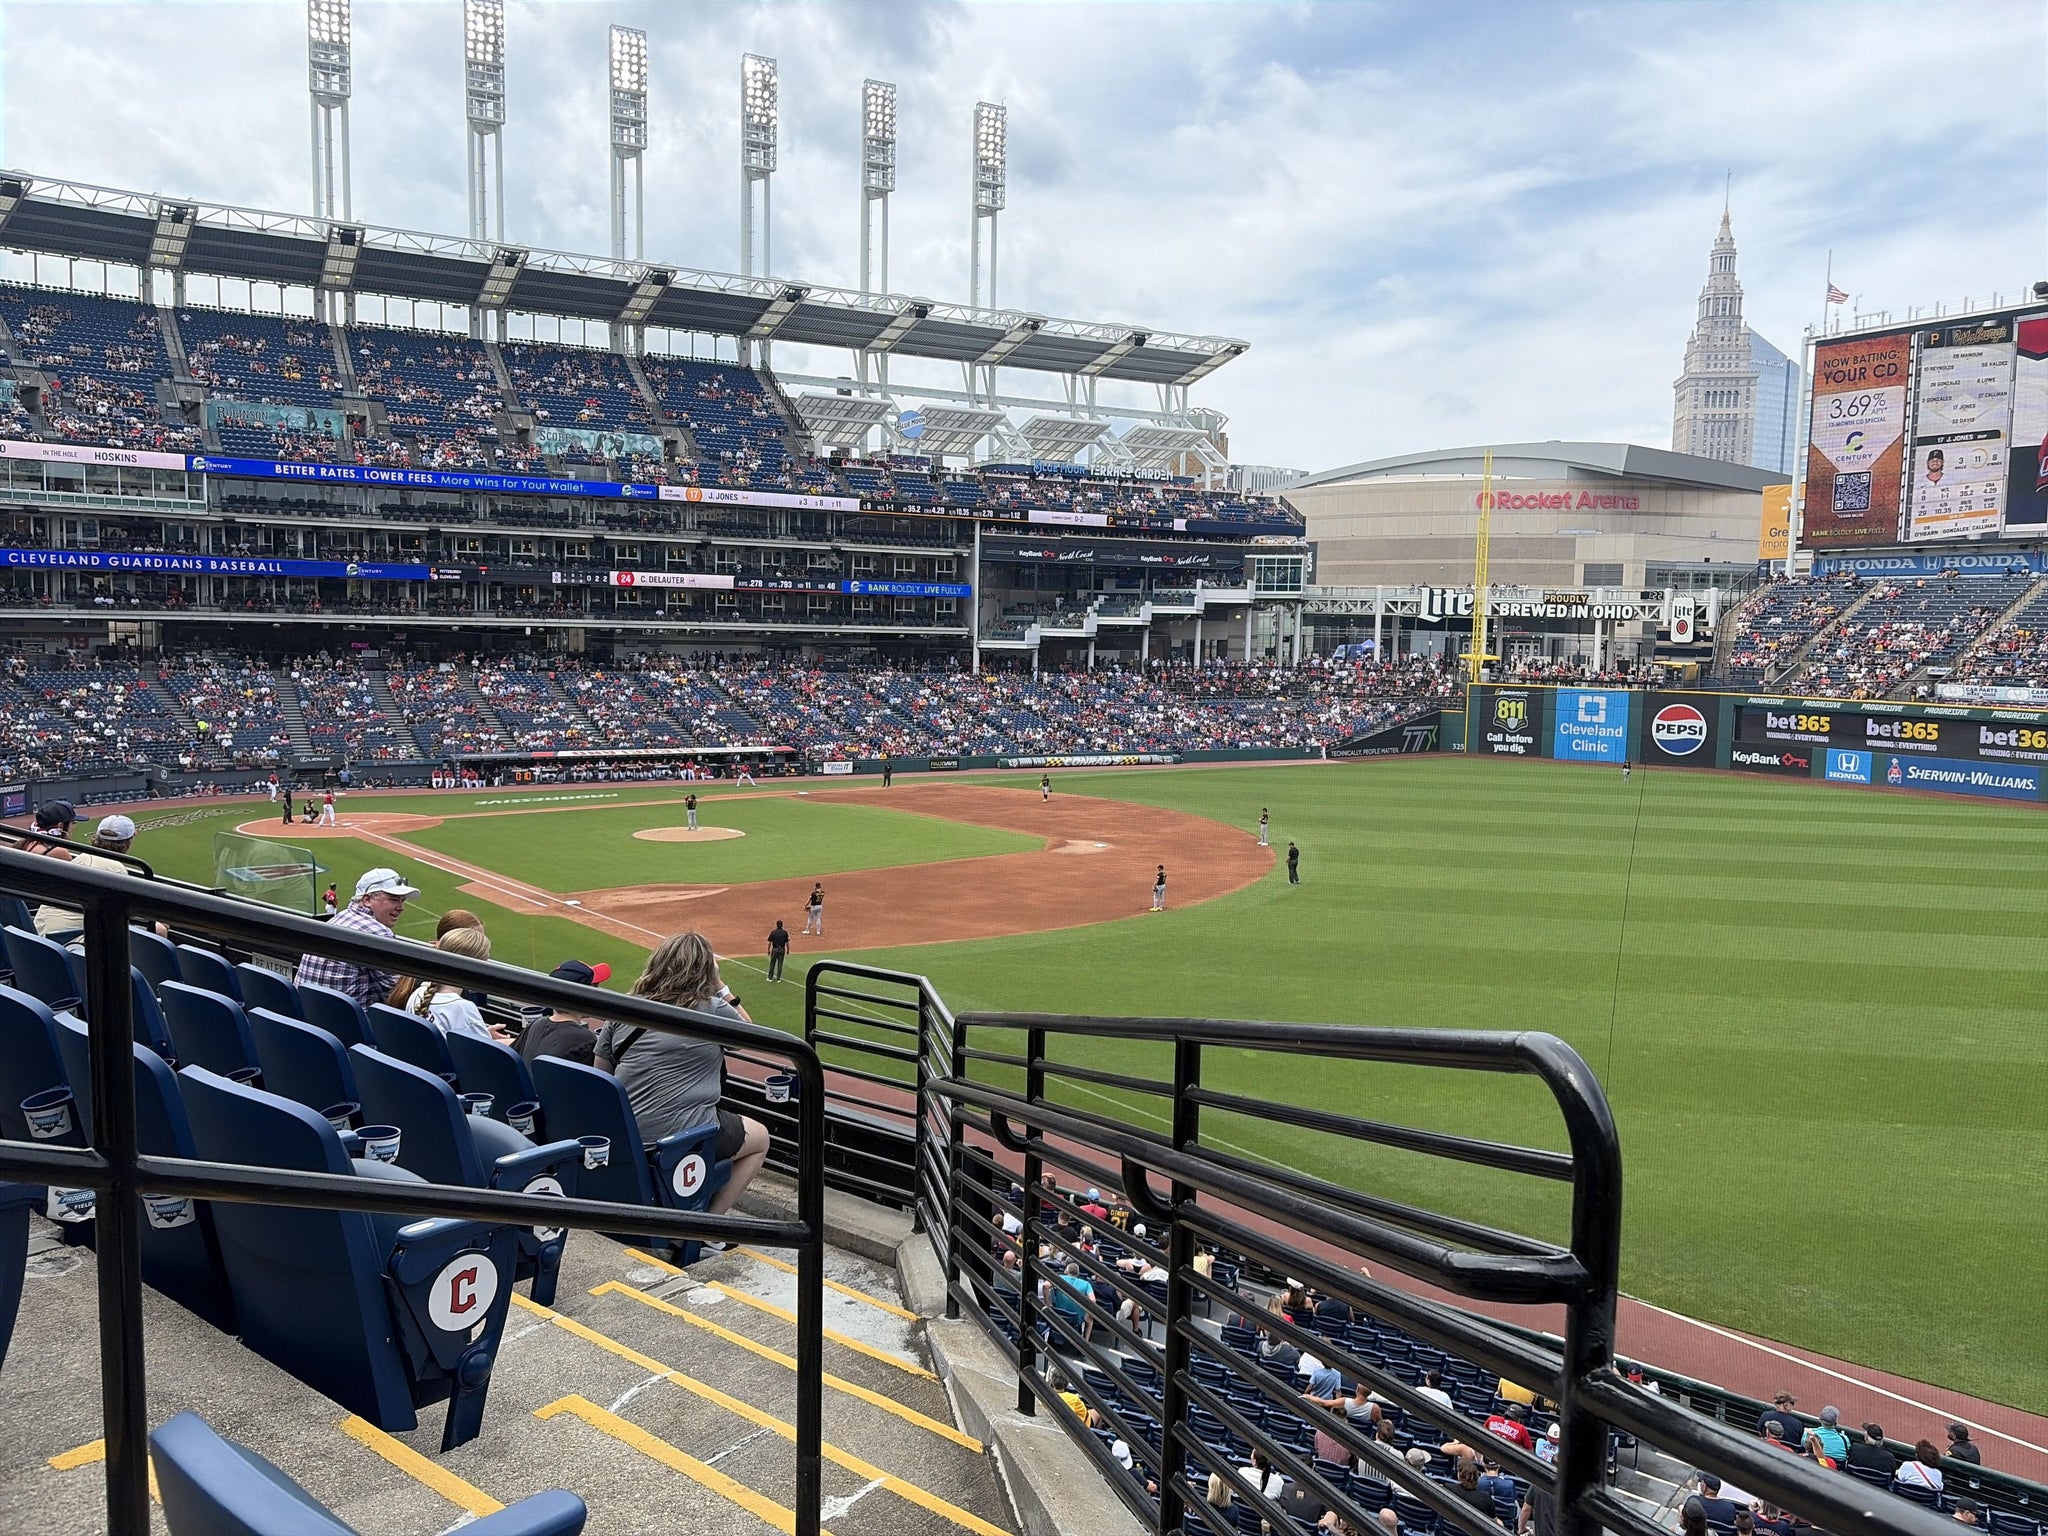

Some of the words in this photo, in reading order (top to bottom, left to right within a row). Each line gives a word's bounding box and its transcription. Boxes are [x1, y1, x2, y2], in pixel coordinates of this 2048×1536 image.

[1823, 357, 1850, 369] NOW
[1853, 350, 1900, 365] BATTING:
[1824, 367, 1867, 385] YOUR
[1873, 362, 1898, 378] CD
[216, 406, 269, 420] ROBINSON
[1830, 392, 1886, 419] 3.69%
[1952, 434, 1974, 442] JONES
[62, 451, 78, 459] HOLE
[94, 452, 138, 463] HOSKINS
[1836, 453, 1873, 462] CENTURY
[1033, 460, 1058, 474] BLUE
[1060, 463, 1086, 475] MOON
[1090, 464, 1134, 478] TERRACE
[1134, 467, 1174, 481] GARDEN
[275, 464, 316, 476] BETTER
[320, 466, 360, 479] RATES.
[364, 470, 404, 482] LOWER
[408, 472, 436, 484] FEES.
[441, 475, 470, 486] More
[474, 477, 499, 488] Wins
[503, 478, 518, 489] for
[521, 480, 546, 490] Your
[550, 481, 588, 493] Wallet.
[690, 490, 698, 499] 17
[708, 492, 715, 500] J.
[716, 492, 738, 501] JONES
[803, 498, 808, 506] 3
[1497, 491, 1572, 510] Rocket
[1576, 491, 1640, 510] Arena
[886, 504, 894, 512] 1-1
[908, 505, 921, 513] 35.2
[931, 506, 945, 515] 4.29
[956, 508, 970, 516] 10.35
[982, 510, 994, 518] 2.78
[1010, 512, 1021, 520] 1.12
[1915, 530, 1939, 538] O'HEARN
[1942, 526, 1969, 534] GONZALES
[8, 552, 100, 566] CLEVELAND
[109, 556, 202, 570] GUARDIANS
[211, 561, 283, 572] BASEBALL
[1019, 550, 1043, 558] KeyBank
[1140, 555, 1163, 563] KeyBank
[1839, 558, 1917, 571] HONDA
[1943, 555, 2030, 568] HONDA
[602, 575, 608, 583] 2
[620, 574, 631, 583] 24
[649, 576, 685, 585] DELAUTER
[748, 579, 763, 588] .278
[778, 581, 793, 589] .793
[805, 581, 812, 590] 11
[827, 582, 836, 590] 46
[868, 583, 890, 592] BANK
[891, 584, 923, 594] BOLDLY.
[924, 585, 940, 594] LIVE
[941, 586, 963, 595] FULLY.
[1417, 586, 1476, 622] Lite
[1544, 594, 1589, 604] PROUDLY
[1499, 603, 1567, 618] BREWED
[1571, 605, 1589, 619] IN
[1592, 605, 1634, 620] OHIO
[1674, 605, 1693, 619] Lite
[1497, 699, 1524, 720] 811
[1748, 697, 1787, 706] PROGRESSIVE
[1802, 700, 1844, 709] PROGRESSIVE
[1860, 704, 1906, 712] PROGRESSIVE
[1924, 707, 1972, 716] PROGRESSIVE
[1991, 710, 2043, 721] PROGRESSIVE
[1560, 723, 1623, 738] Cleveland
[1656, 724, 1704, 736] PEPSI
[1766, 712, 1831, 733] bet365
[1866, 718, 1939, 740] bet365
[1979, 726, 2048, 749] bet36
[1487, 732, 1503, 743] Call
[1506, 733, 1534, 744] before
[1766, 731, 1791, 740] WINNING
[1794, 734, 1830, 744] EVERYTHING
[1866, 739, 1895, 748] WINNING
[1899, 742, 1938, 752] EVERYTHING
[1979, 748, 2010, 758] WINNING
[1331, 749, 1362, 757] TECHNICALLY,
[1363, 748, 1381, 756] PEOPLE
[1381, 747, 1399, 755] MATTER.
[1452, 742, 1465, 751] 325
[1493, 744, 1509, 753] you
[1510, 744, 1526, 754] dig.
[1572, 739, 1608, 753] Clinic
[1064, 756, 1122, 767] CONRAD'S
[1732, 750, 1781, 766] KeyBank
[1829, 771, 1867, 781] HONDA
[1907, 766, 2037, 790] SHERWIN-WILLIAMS.
[682, 1161, 697, 1188] C
[74, 1202, 92, 1210] FIELD
[1110, 1216, 1128, 1232] 21
[450, 1266, 478, 1314] C
